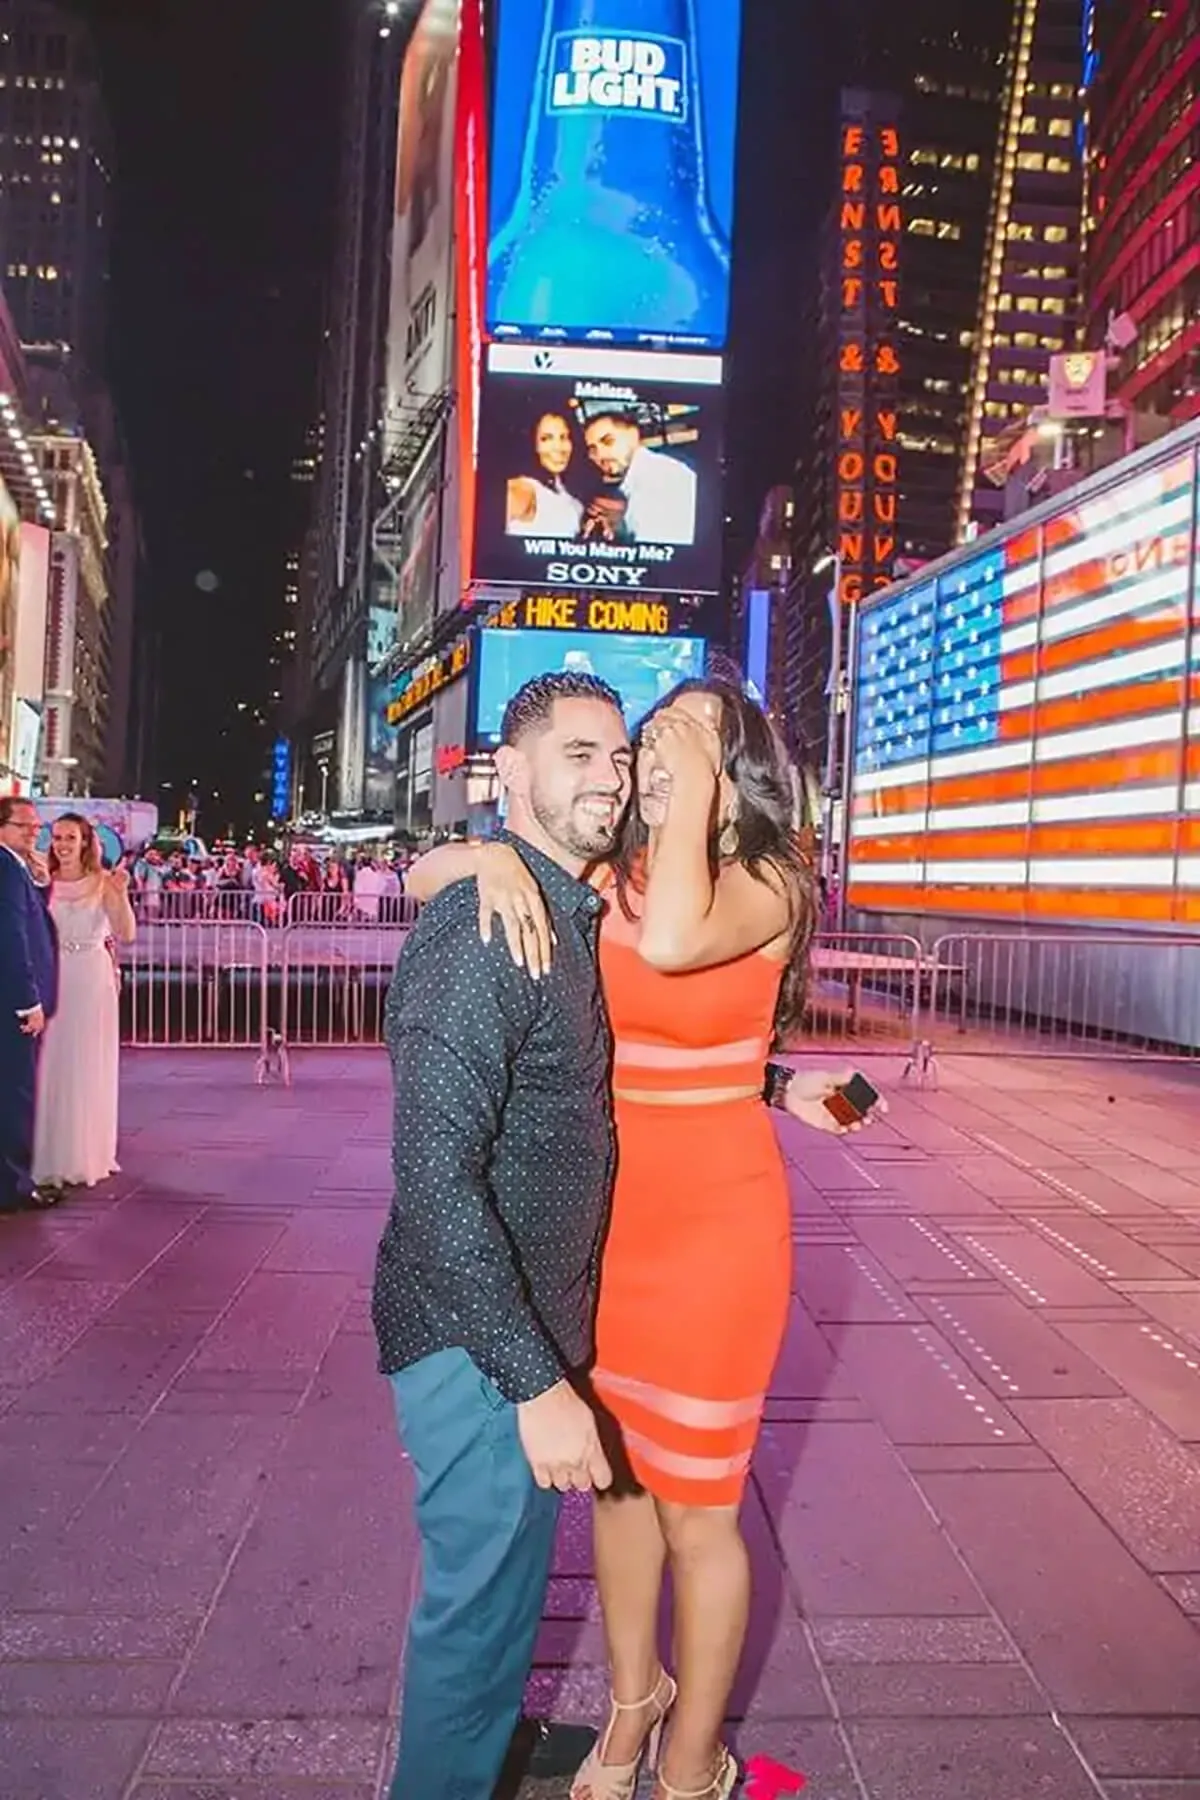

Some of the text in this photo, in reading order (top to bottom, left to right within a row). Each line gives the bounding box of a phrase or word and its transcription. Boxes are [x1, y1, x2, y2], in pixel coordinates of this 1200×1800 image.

[571, 38, 665, 75] BUD
[553, 72, 680, 113] LIGHT
[838, 124, 865, 603] ERNST & YOUNG
[524, 539, 674, 562] Will You Marry Me?
[547, 562, 648, 585] SONY
[525, 597, 578, 628] HIKE
[588, 599, 669, 634] COMING
